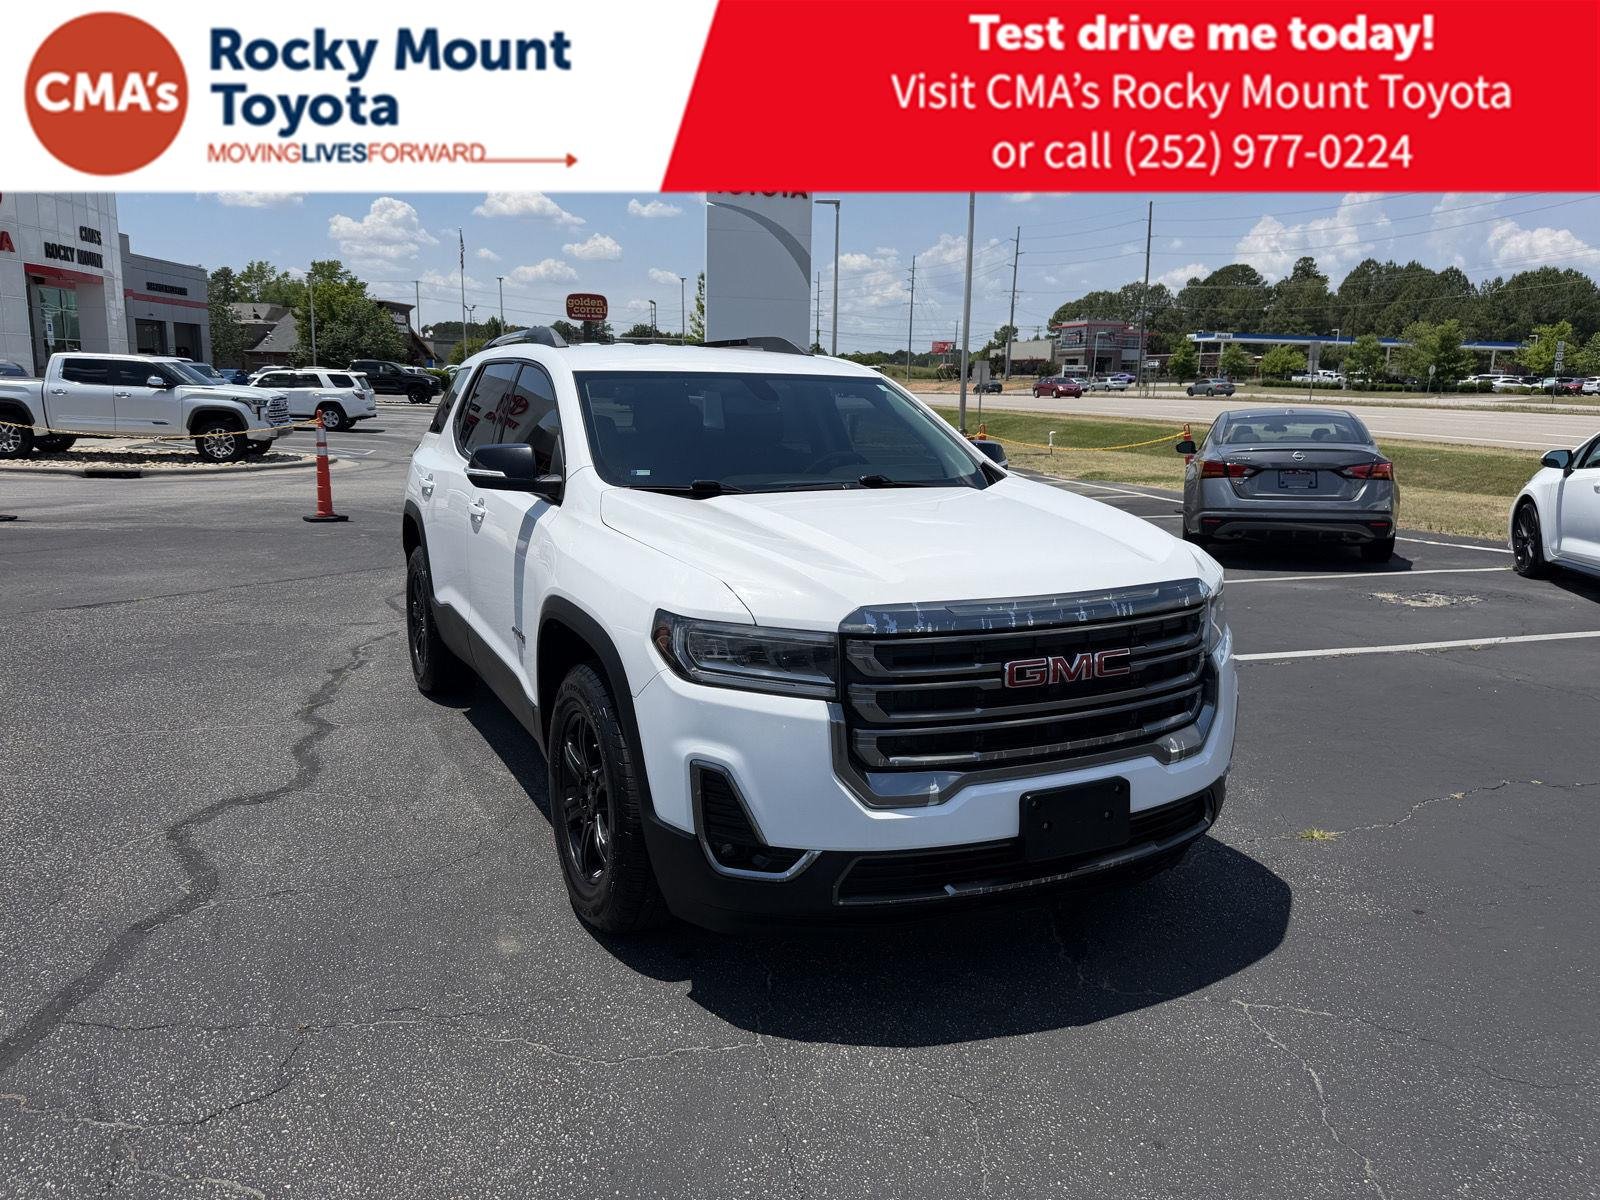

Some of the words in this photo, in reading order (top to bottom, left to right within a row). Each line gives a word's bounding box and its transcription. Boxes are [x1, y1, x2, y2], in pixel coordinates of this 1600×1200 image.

[44, 241, 75, 263] ROCKY
[77, 249, 103, 269] MOUNT
[568, 298, 602, 307] golden
[574, 306, 606, 314] corral
[1004, 647, 1131, 689] GMC
